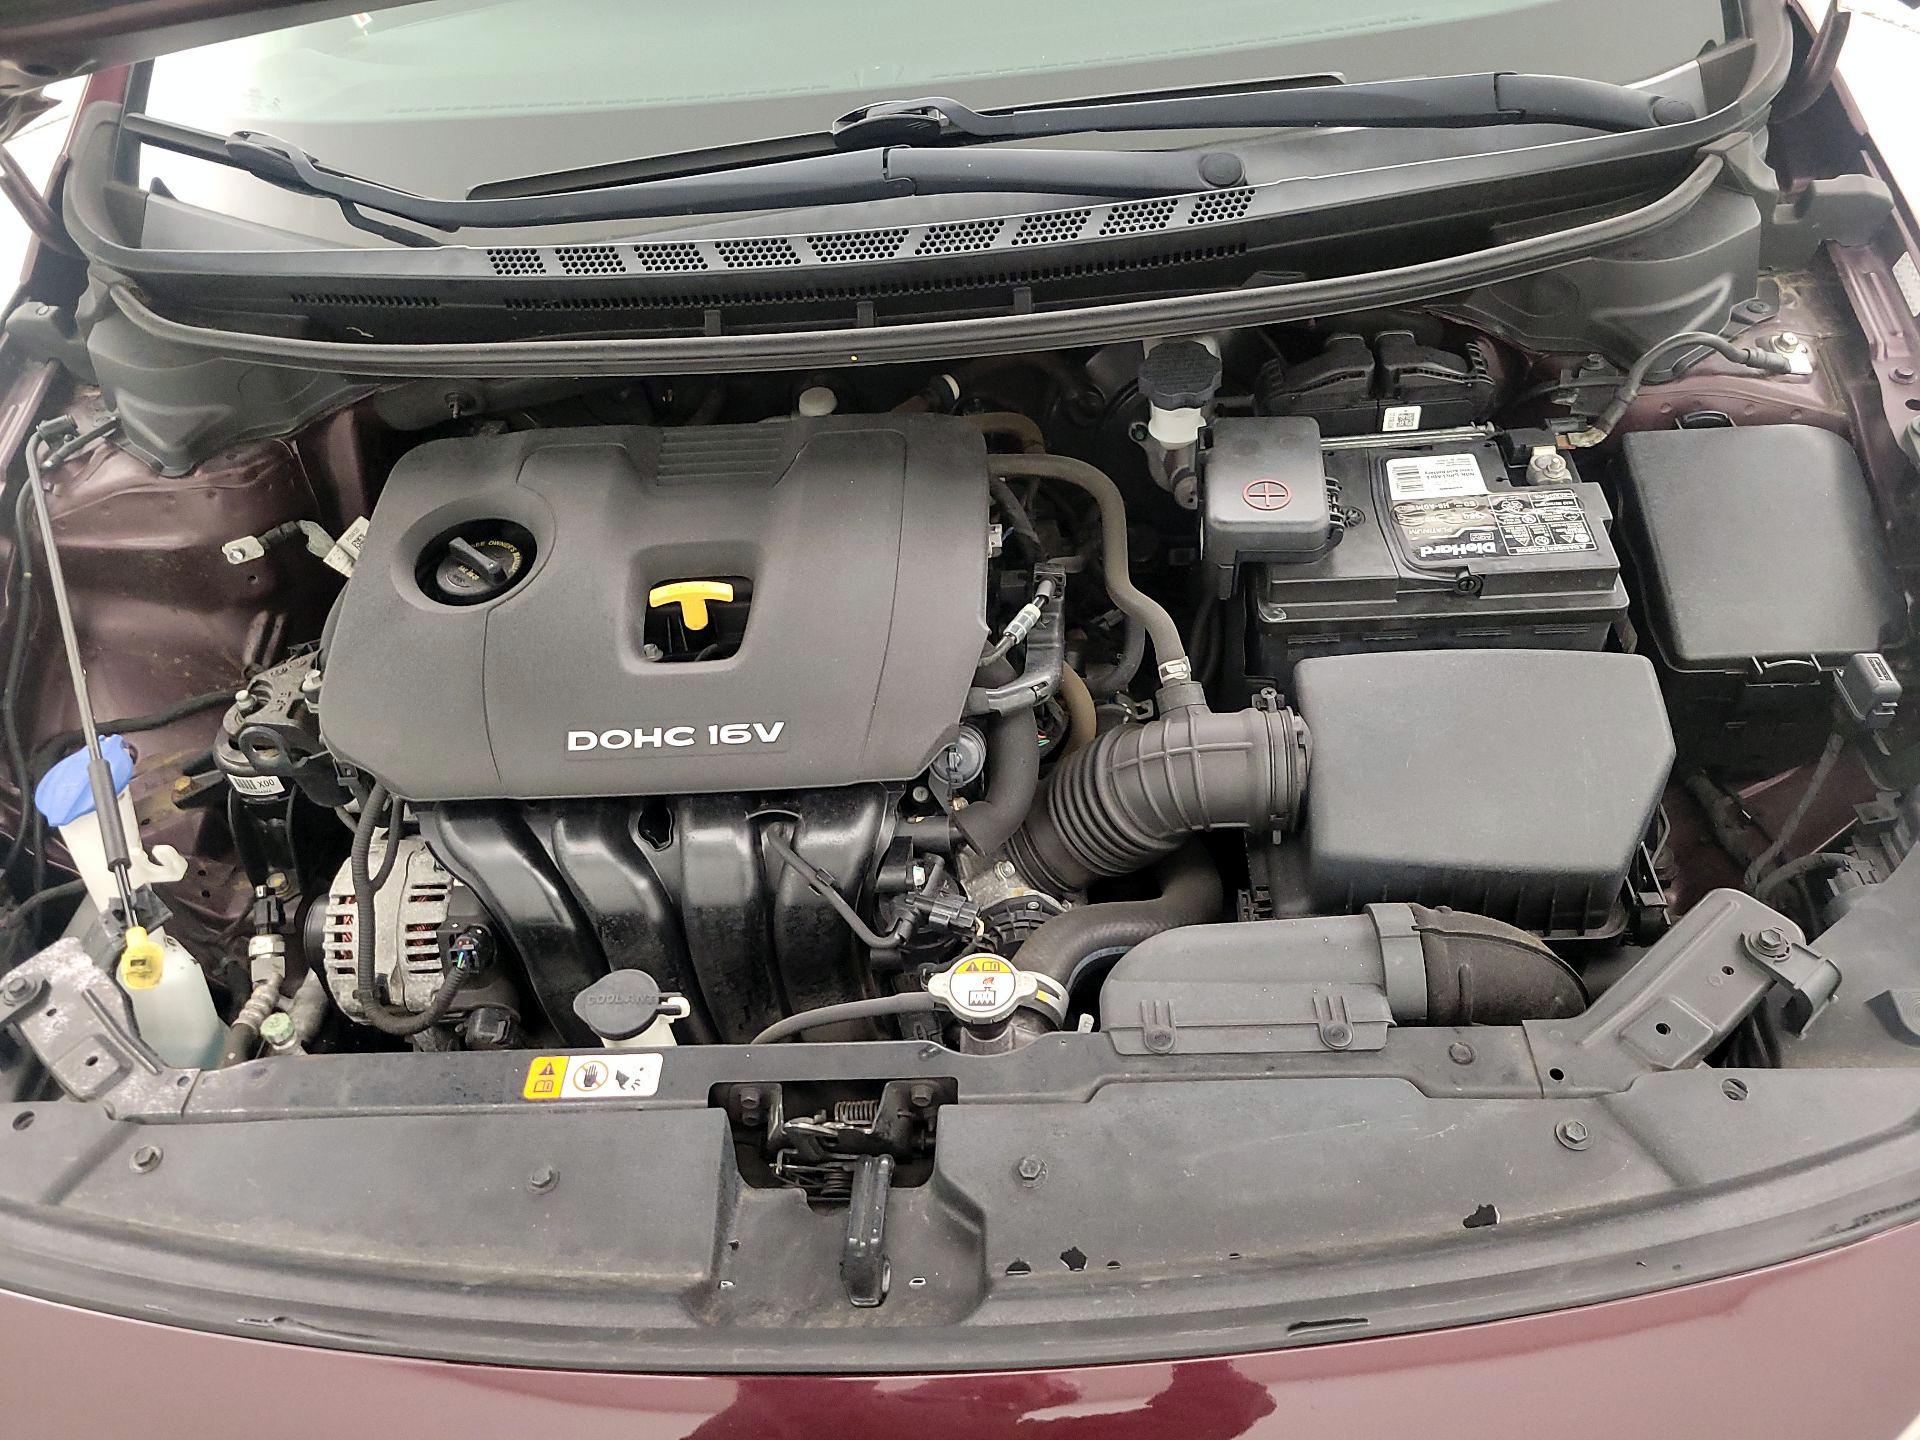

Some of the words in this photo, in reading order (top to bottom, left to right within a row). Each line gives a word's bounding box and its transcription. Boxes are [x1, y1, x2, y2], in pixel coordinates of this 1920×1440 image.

[1408, 527, 1453, 535] PLATINUM
[1420, 541, 1497, 558] DieHard
[567, 726, 696, 751] DOHC
[708, 720, 785, 746] 16V
[257, 778, 275, 788] X00
[586, 993, 658, 1006] COOLANT
